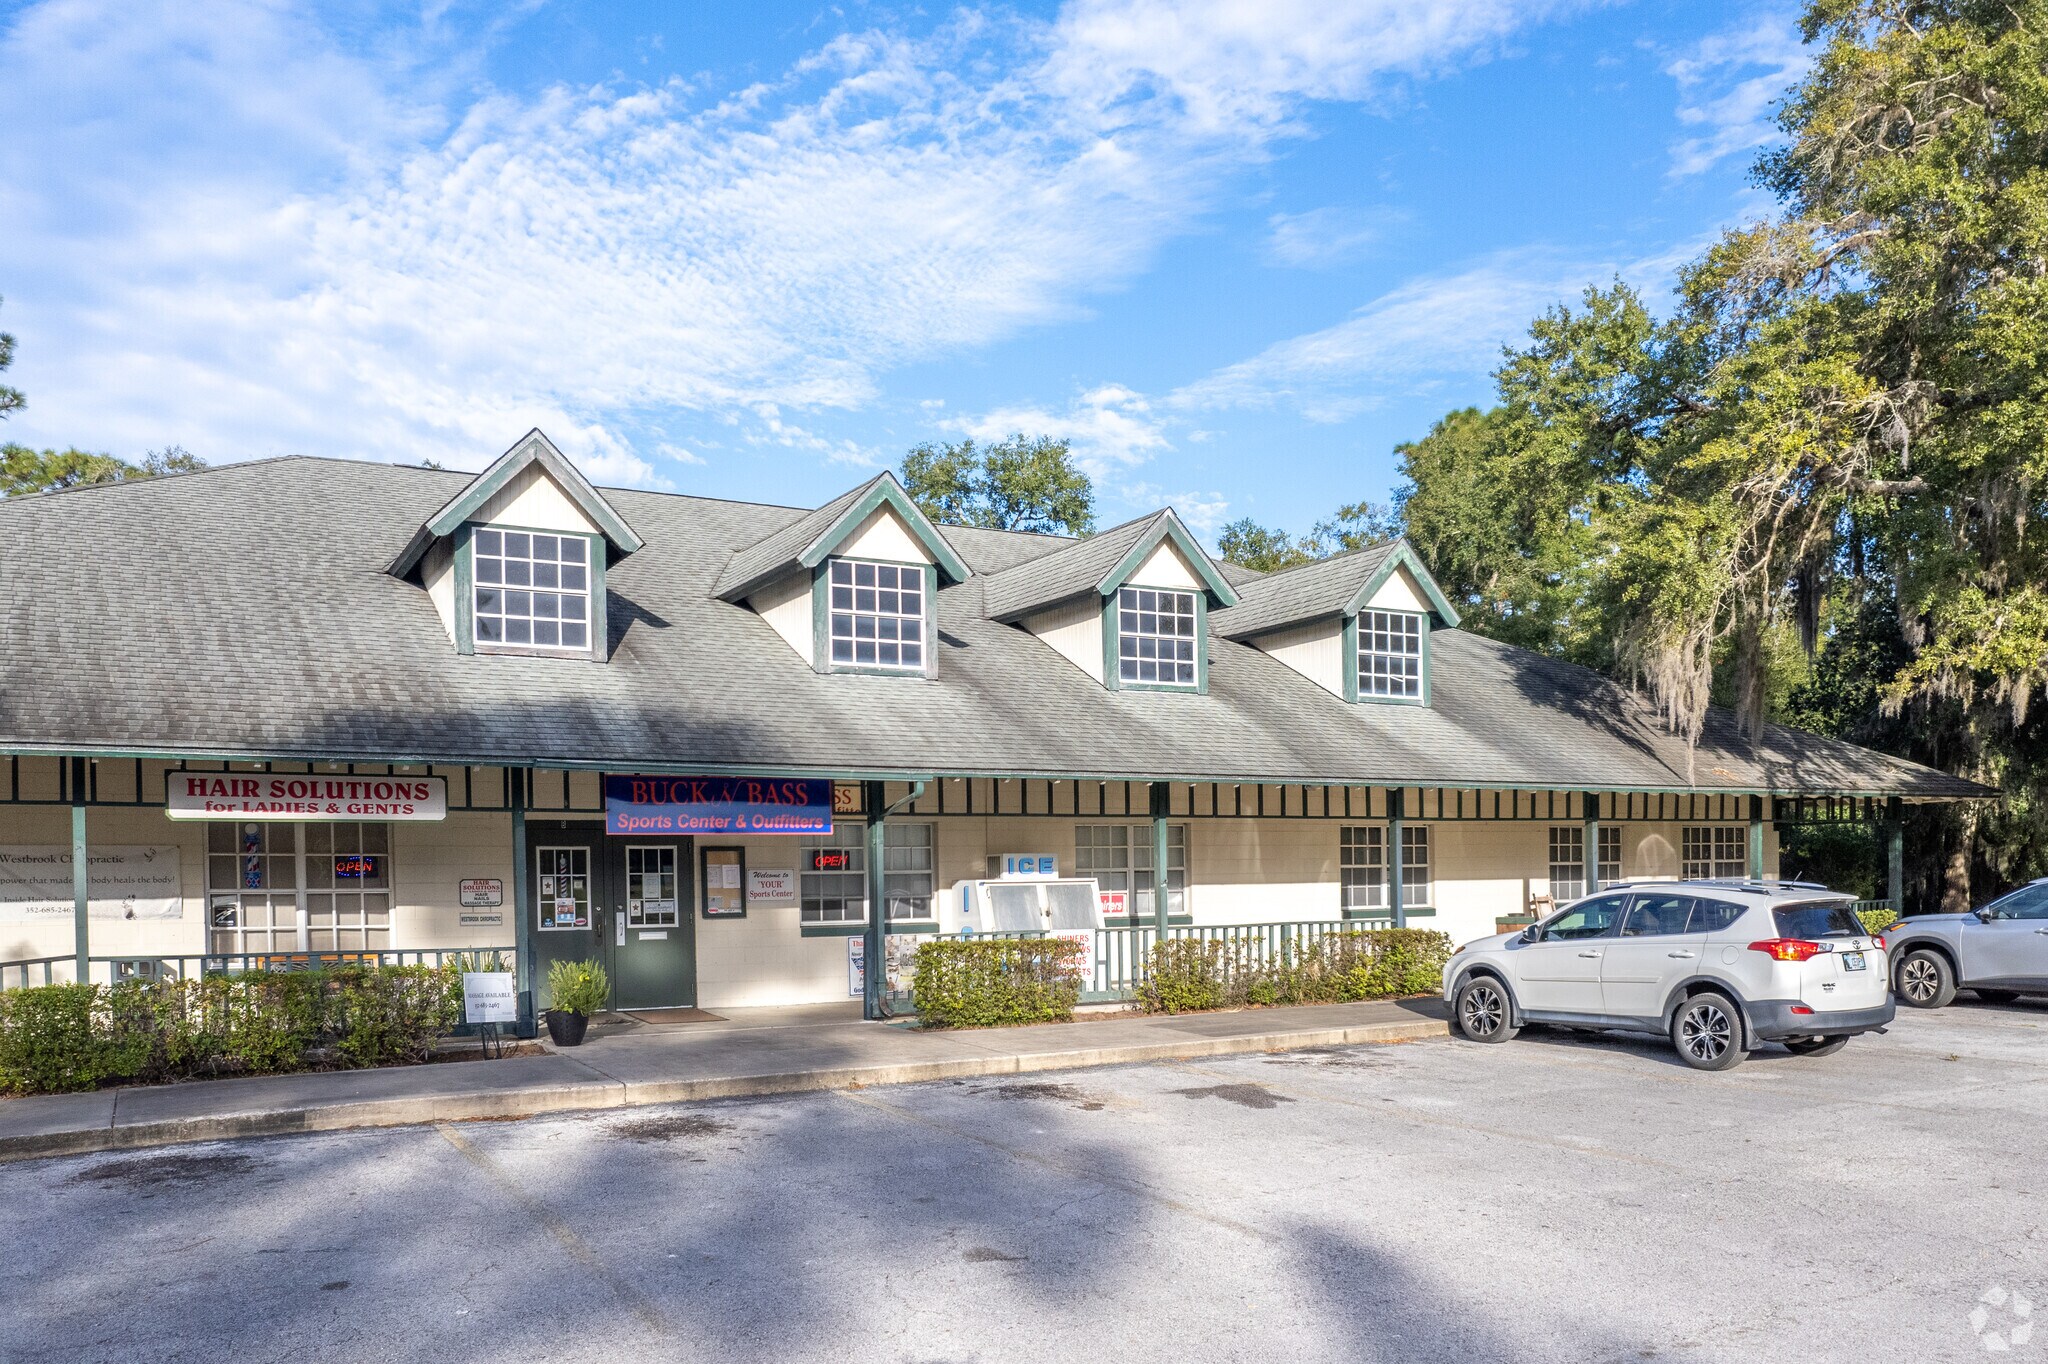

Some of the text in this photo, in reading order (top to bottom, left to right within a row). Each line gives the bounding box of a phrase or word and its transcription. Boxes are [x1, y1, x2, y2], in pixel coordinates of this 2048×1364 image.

[187, 778, 430, 801] HAIR SOLUTIONS
[631, 781, 709, 805] BUCK
[747, 783, 809, 806] BASS
[835, 789, 851, 804] SS
[205, 801, 415, 815] for LADIES & GENTS
[617, 813, 824, 831] Sports Center & Outfitters
[0, 854, 124, 865] Westbrook Chopractic
[336, 861, 372, 871] OPEN
[815, 855, 848, 867] OPEN
[1008, 857, 1054, 874] ICE
[91, 876, 113, 885] body
[113, 876, 136, 884] heals
[137, 876, 151, 884] the
[152, 876, 175, 885] body!
[749, 890, 793, 899] Sports Center
